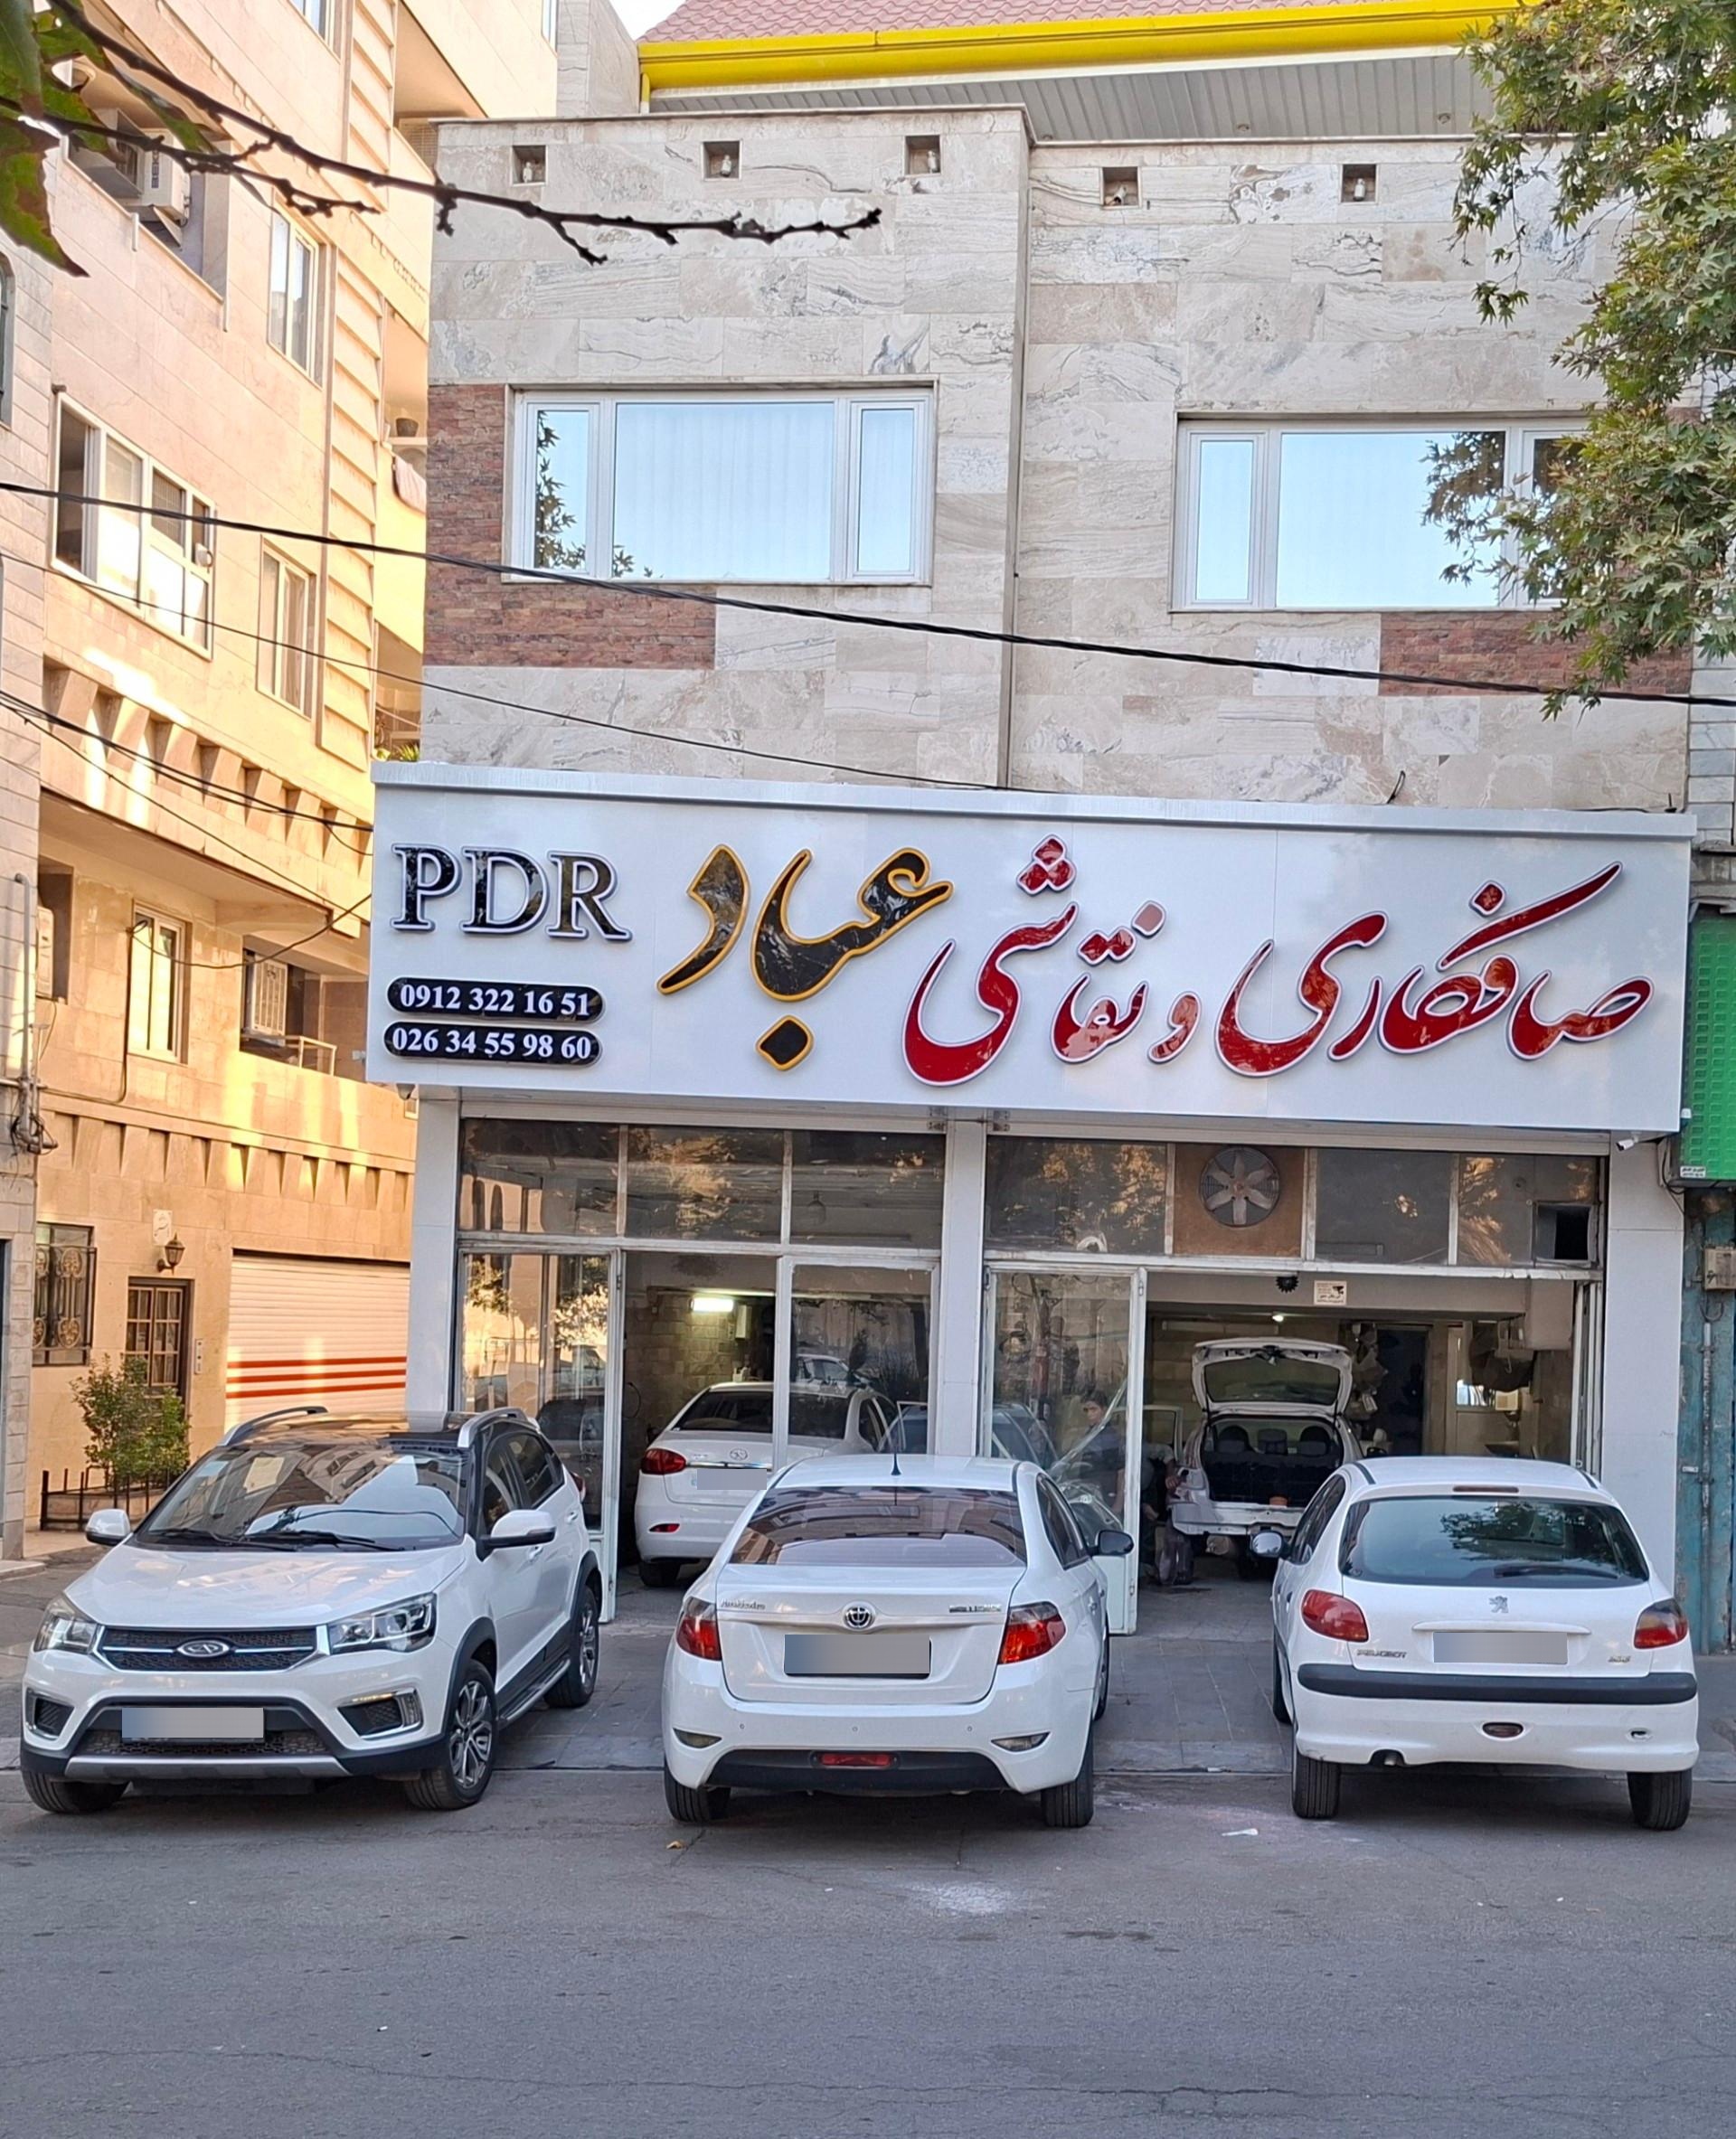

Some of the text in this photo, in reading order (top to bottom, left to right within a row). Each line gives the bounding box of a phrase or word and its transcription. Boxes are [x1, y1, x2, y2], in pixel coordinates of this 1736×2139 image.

[391, 843, 632, 941] PDR
[656, 834, 1655, 1088] صافکاری و نقاشی عباد
[400, 984, 590, 1016] 0912 322 16 51
[392, 1027, 591, 1060] 026 34 55 98 60
